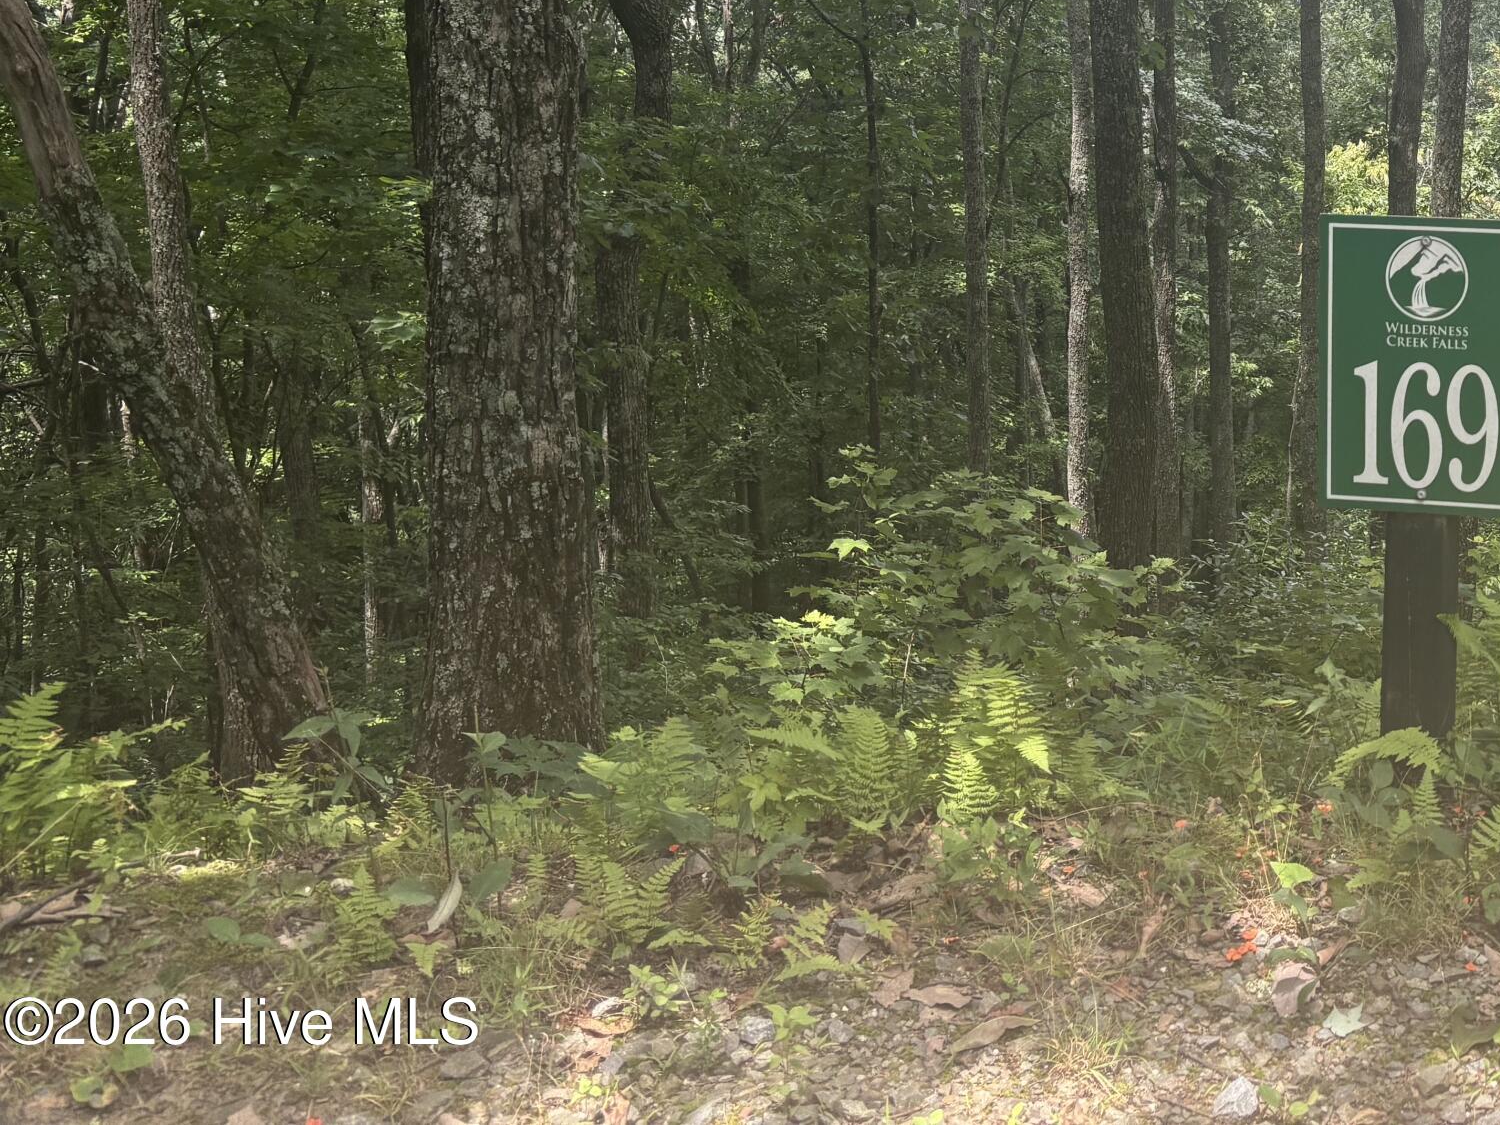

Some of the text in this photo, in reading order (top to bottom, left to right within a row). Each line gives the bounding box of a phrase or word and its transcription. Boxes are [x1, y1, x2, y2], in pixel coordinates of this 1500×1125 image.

[1385, 321, 1469, 337] WILDERNESS
[1386, 335, 1468, 350] CREEK FALLS
[1353, 360, 1499, 492] 169
